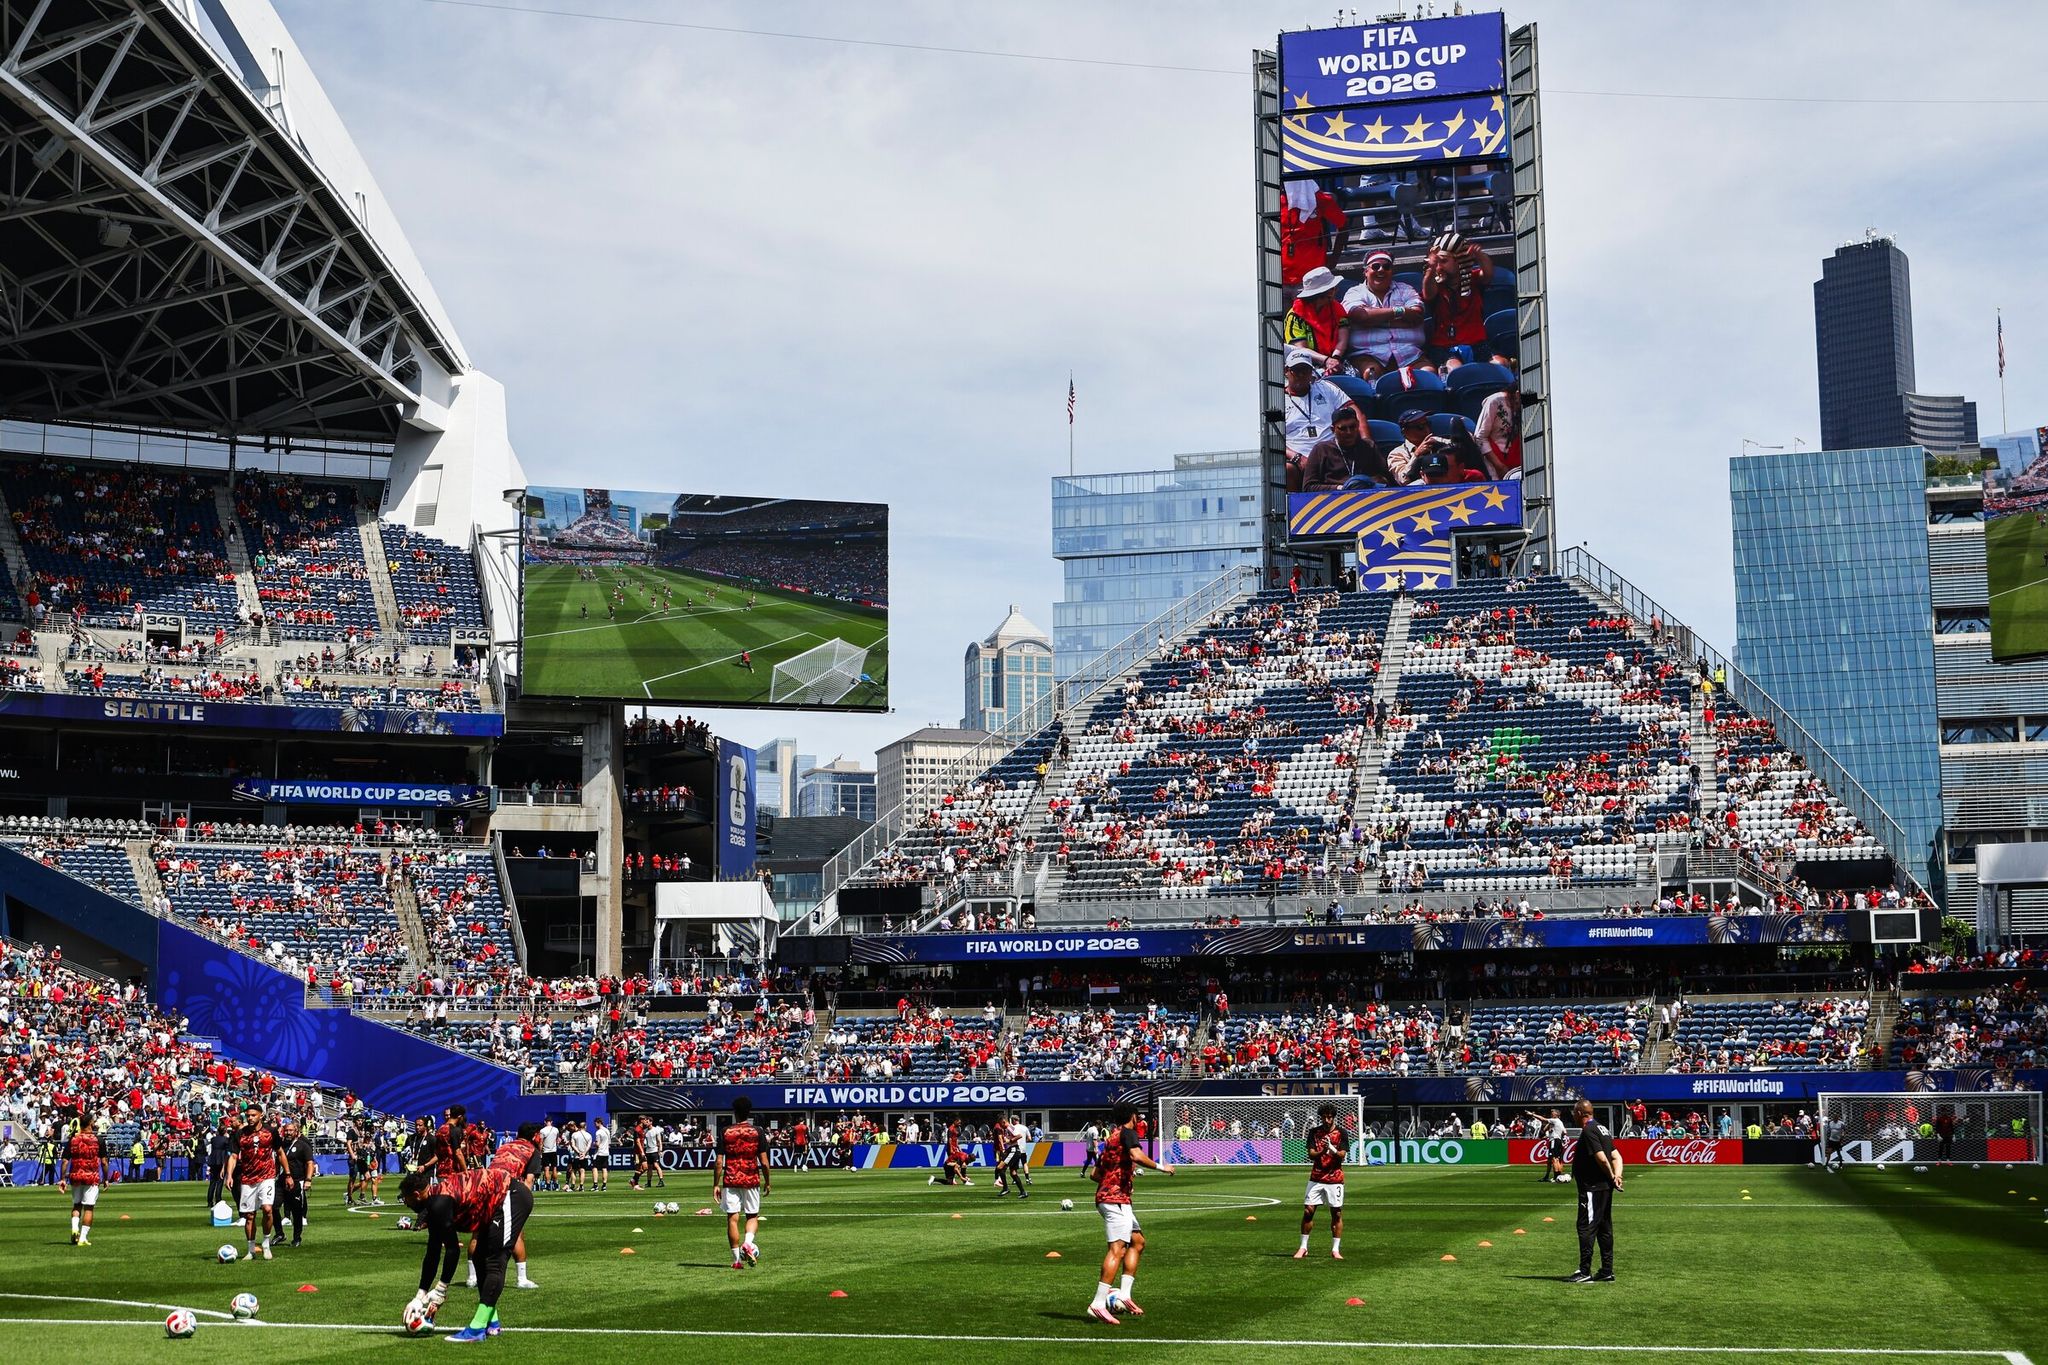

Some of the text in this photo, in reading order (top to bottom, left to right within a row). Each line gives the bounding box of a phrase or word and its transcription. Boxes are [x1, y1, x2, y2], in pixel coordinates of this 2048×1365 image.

[1363, 26, 1418, 49] FIFA
[1317, 44, 1466, 76] WORLD CUP
[1346, 71, 1437, 97] 2026
[146, 615, 179, 626] 343
[456, 630, 490, 640] 344
[104, 700, 205, 721] SEATTLE
[270, 785, 451, 802] FIFA WORLD CUP 2026
[730, 833, 746, 847] 2026
[1294, 933, 1366, 946] SEATTLE
[1588, 926, 1654, 939] #FIFAWorldCup
[966, 938, 1140, 953] FIFA WORLD CUP 2026
[784, 1086, 1027, 1104] FIFA WORLD CUP 2026
[1261, 1082, 1360, 1096] SEATTLE
[1692, 1079, 1784, 1095] #FIFAWorldCup
[919, 1143, 987, 1167] VA
[1344, 1140, 1463, 1164] ramco
[1646, 1139, 1720, 1164] Coca-Cola
[660, 1149, 726, 1171] QATA
[266, 1185, 273, 1196] 2
[1336, 1185, 1342, 1198] 3
